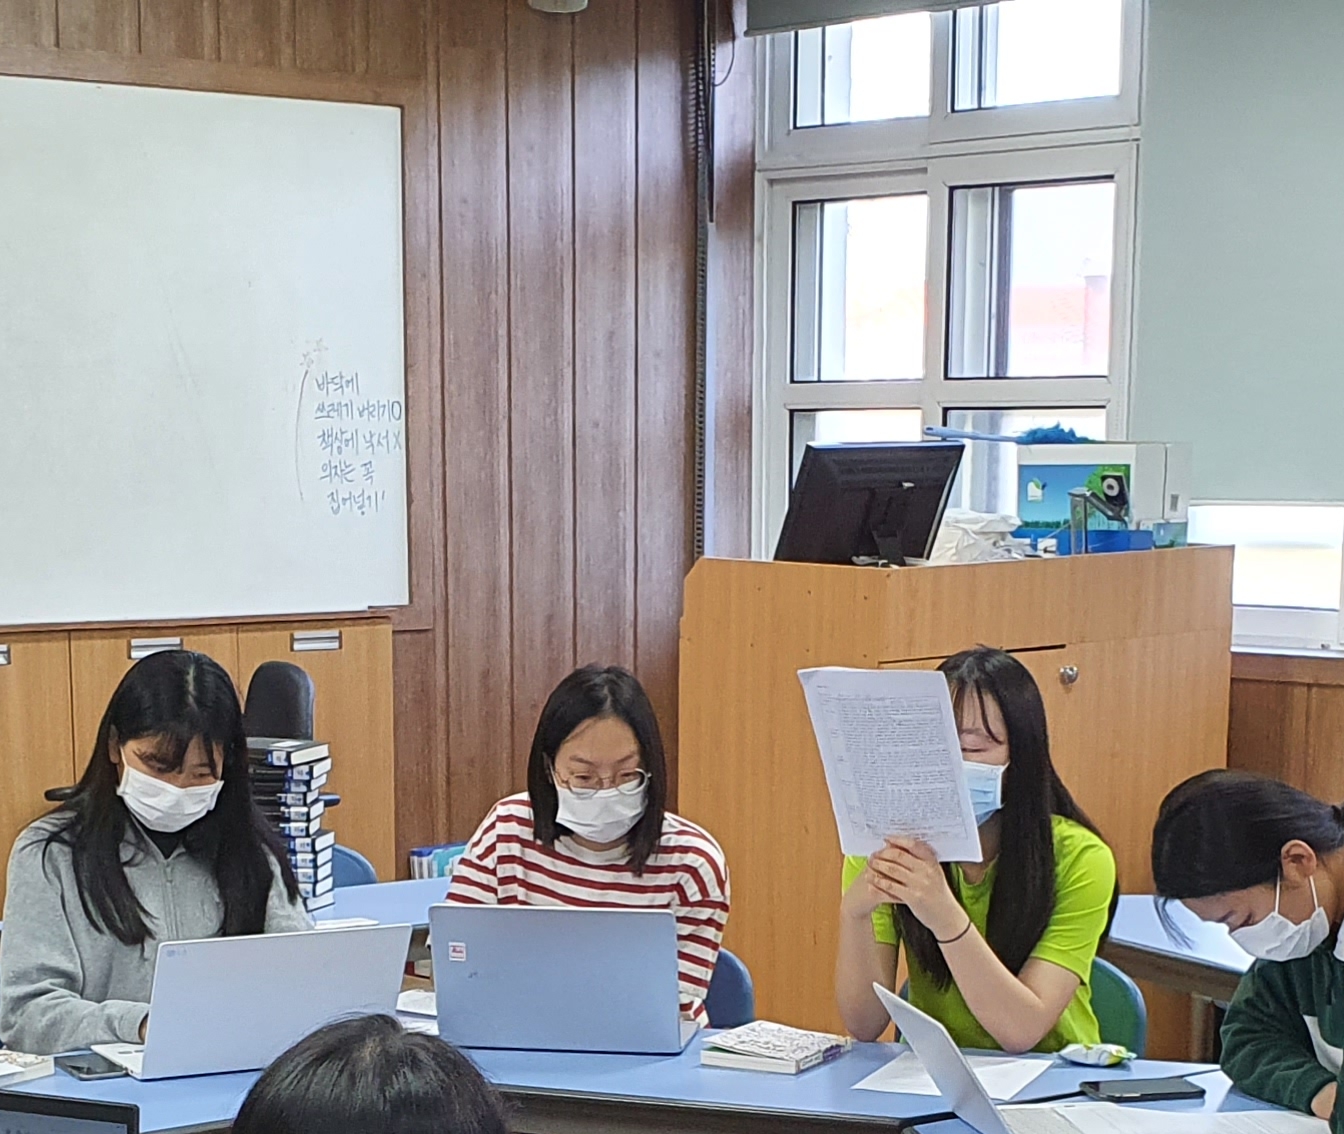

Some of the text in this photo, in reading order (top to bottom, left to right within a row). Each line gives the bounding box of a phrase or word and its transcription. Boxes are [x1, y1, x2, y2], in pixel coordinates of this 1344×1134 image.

[315, 371, 360, 396] 바닥에
[314, 400, 354, 420] 쓰레기
[317, 427, 359, 456] 책상에
[363, 430, 390, 455] 낙서
[320, 460, 376, 485] 의자는 꼭
